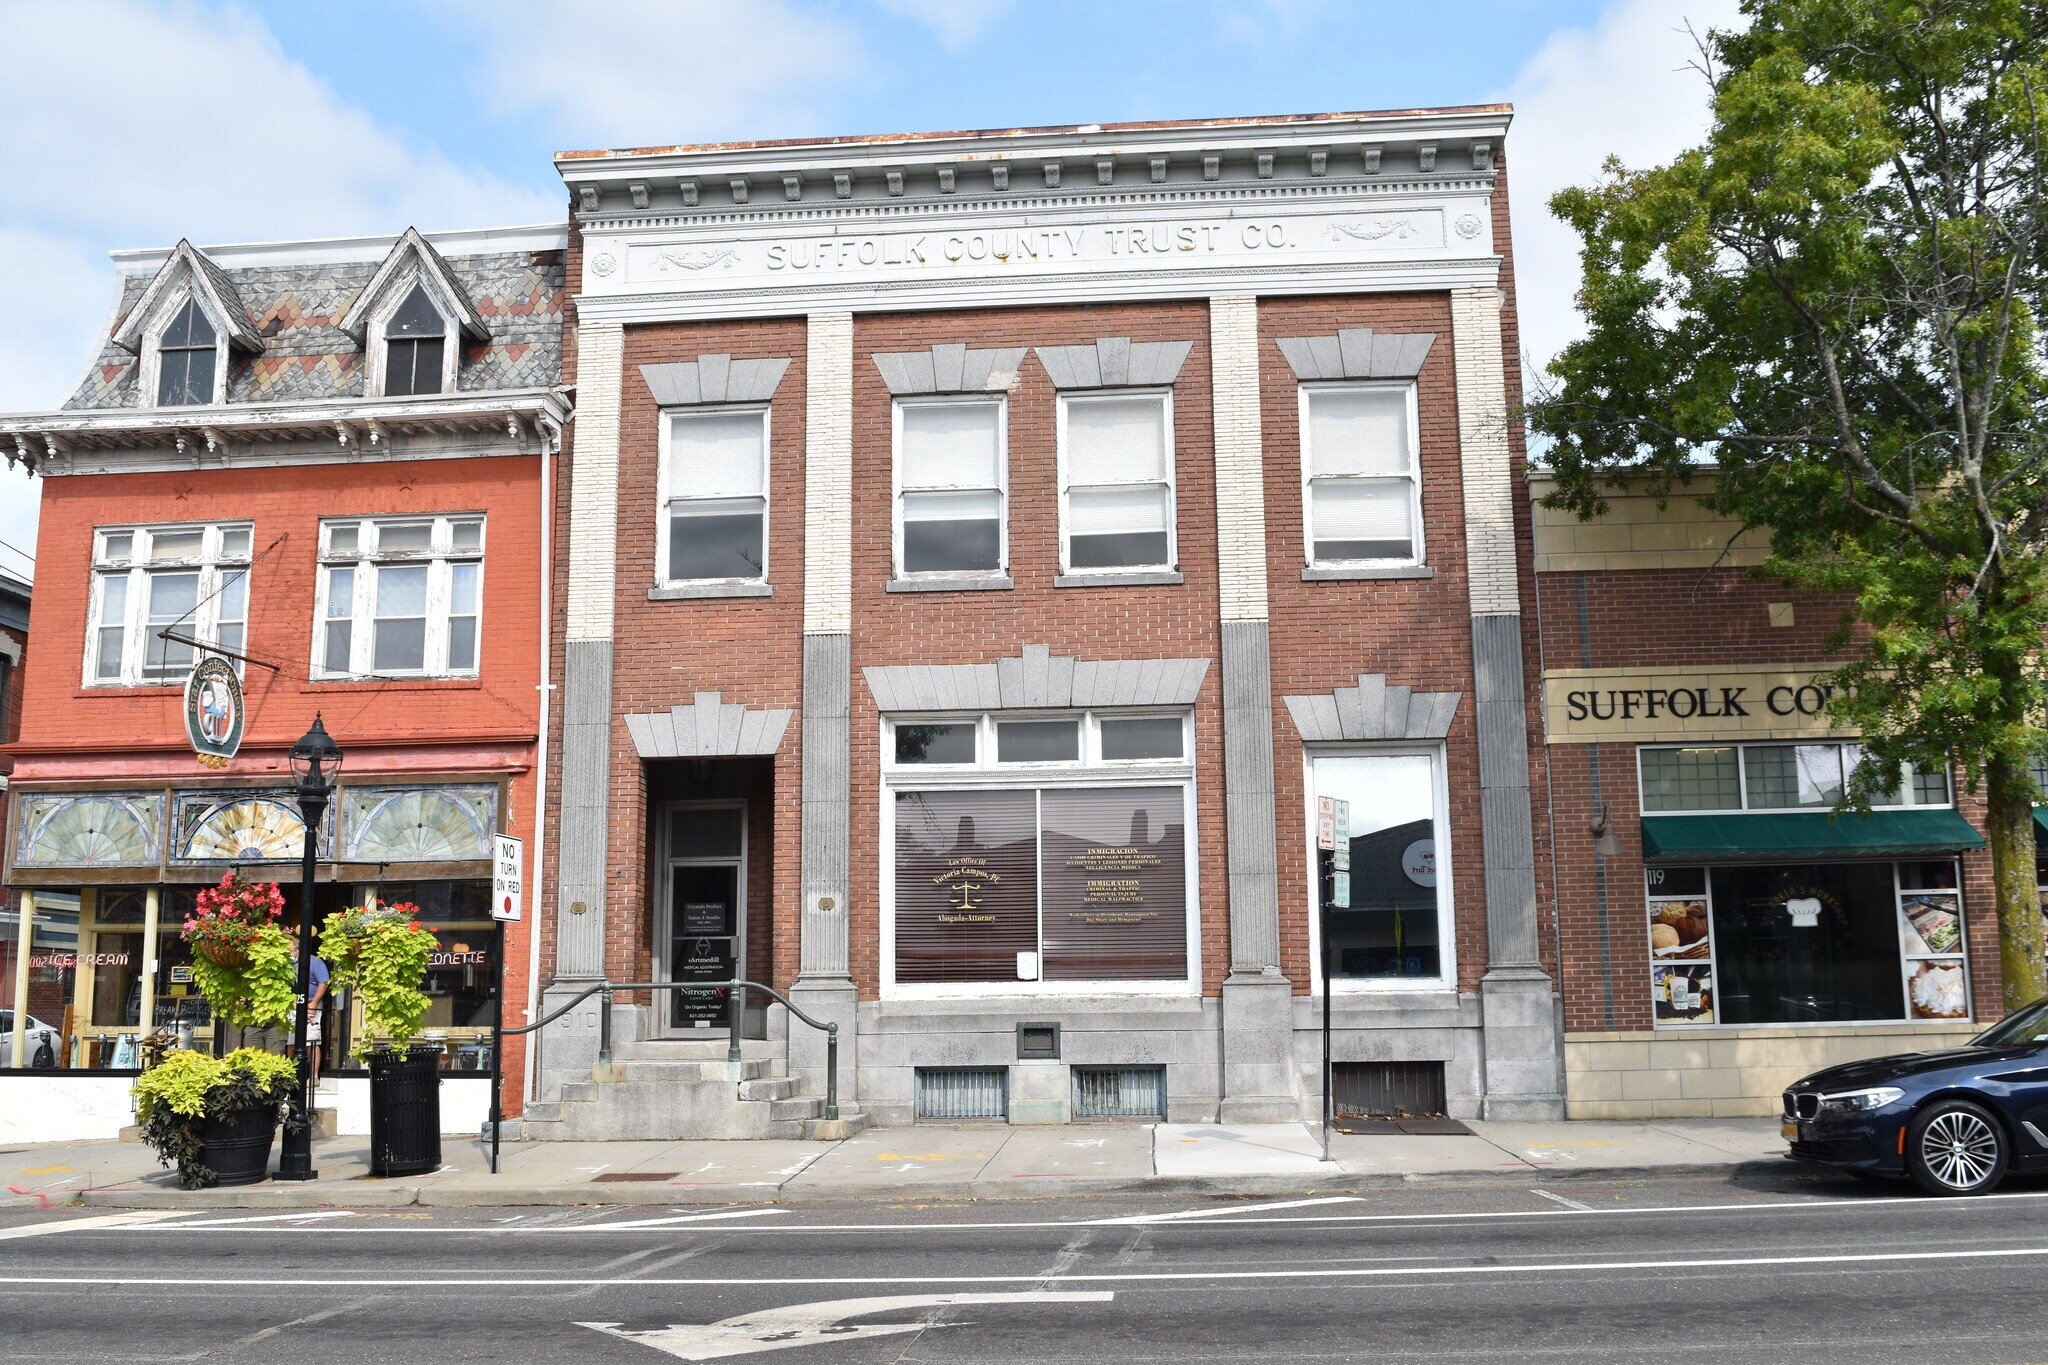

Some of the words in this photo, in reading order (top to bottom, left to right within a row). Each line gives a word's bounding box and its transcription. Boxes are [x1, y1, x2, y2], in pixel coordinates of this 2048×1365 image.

[766, 236, 926, 270] SUFFOLK
[943, 229, 1085, 263] COUNTY
[1104, 225, 1221, 255] TRUST
[1241, 224, 1297, 250] CO.
[189, 680, 200, 713] Star
[1567, 687, 1750, 721] SUFFOLK
[502, 843, 515, 859] NO
[501, 862, 517, 876] TURN
[933, 868, 960, 884] Victoria
[990, 873, 1001, 884] PC
[1647, 869, 1665, 885] 119
[496, 879, 505, 891] ON
[507, 881, 520, 894] RED
[938, 914, 996, 923] Abogada-Attorney
[49, 953, 74, 965] ICE
[76, 953, 129, 966] CREAM
